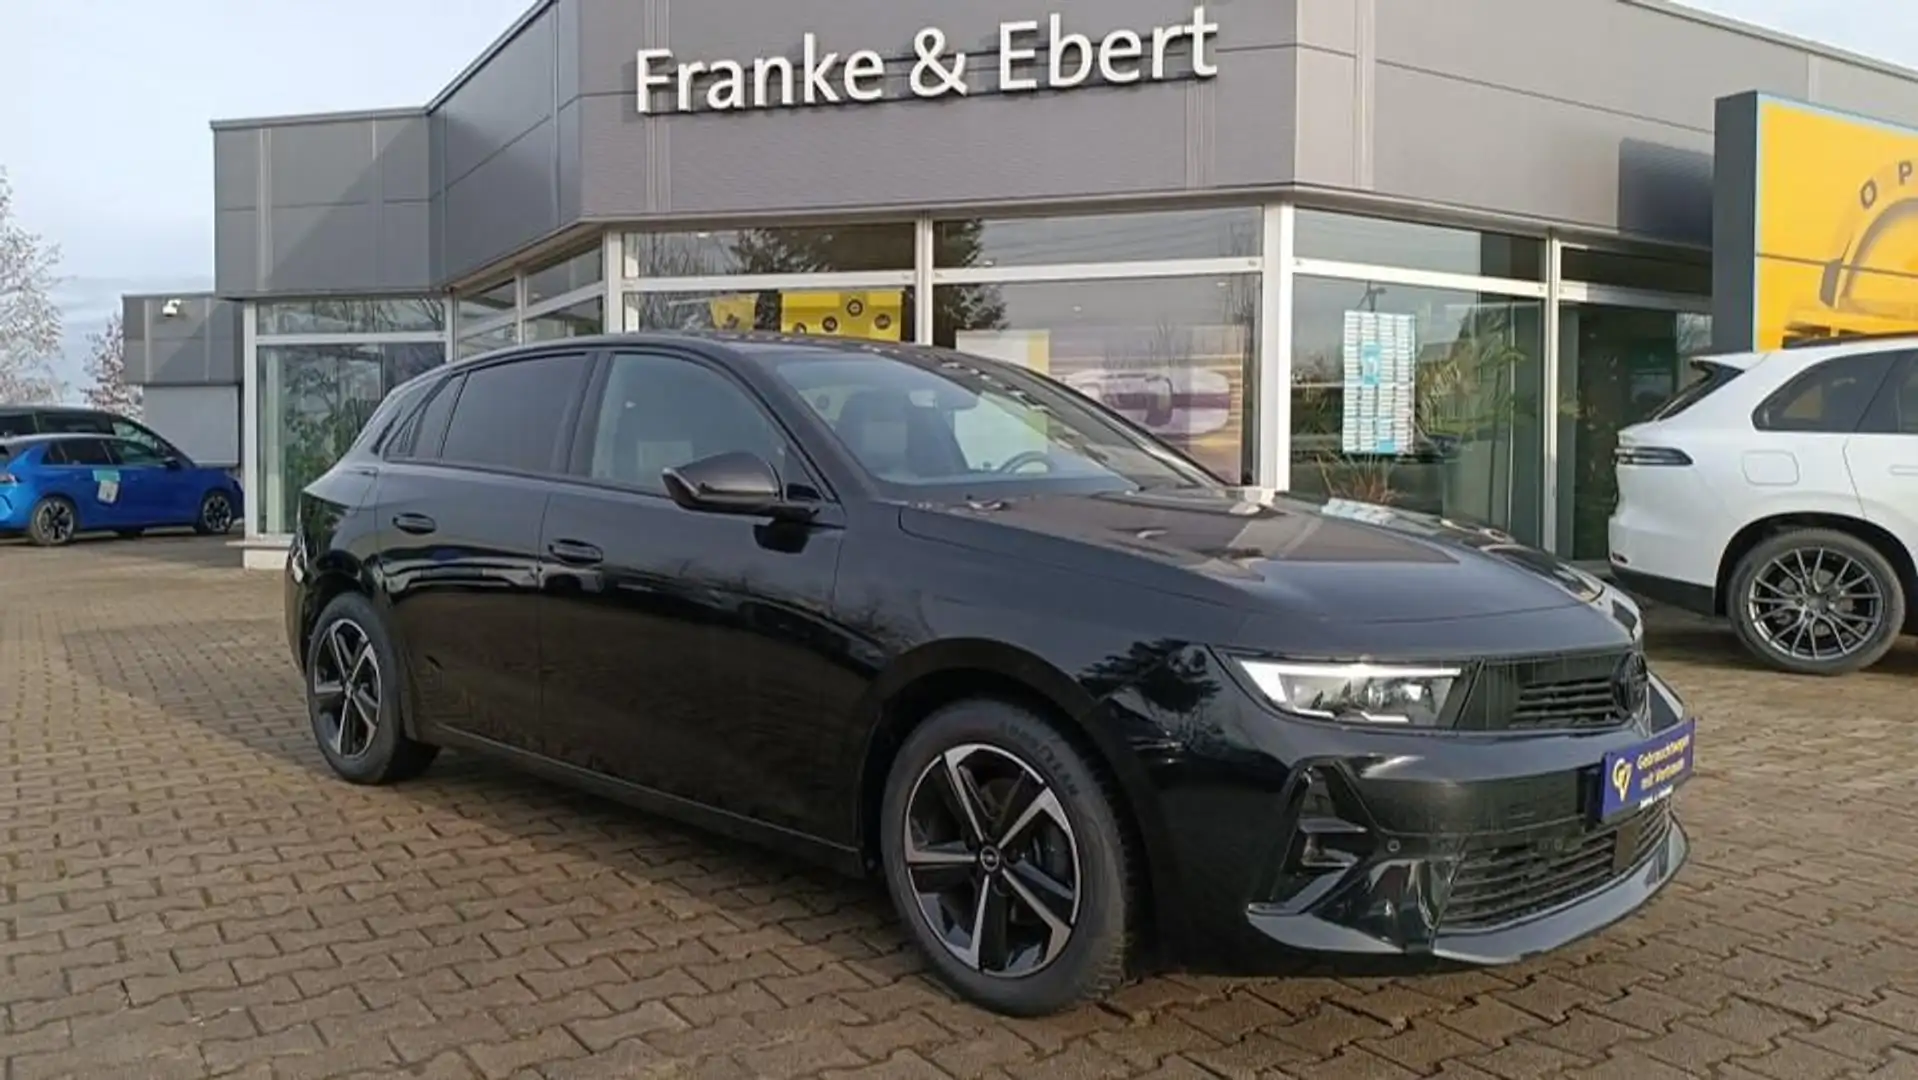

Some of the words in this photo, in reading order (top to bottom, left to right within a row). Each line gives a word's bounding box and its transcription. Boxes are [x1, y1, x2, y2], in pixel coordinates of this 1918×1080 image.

[635, 32, 885, 114] Franke
[908, 27, 968, 97] &
[998, 6, 1219, 92] Ebert
